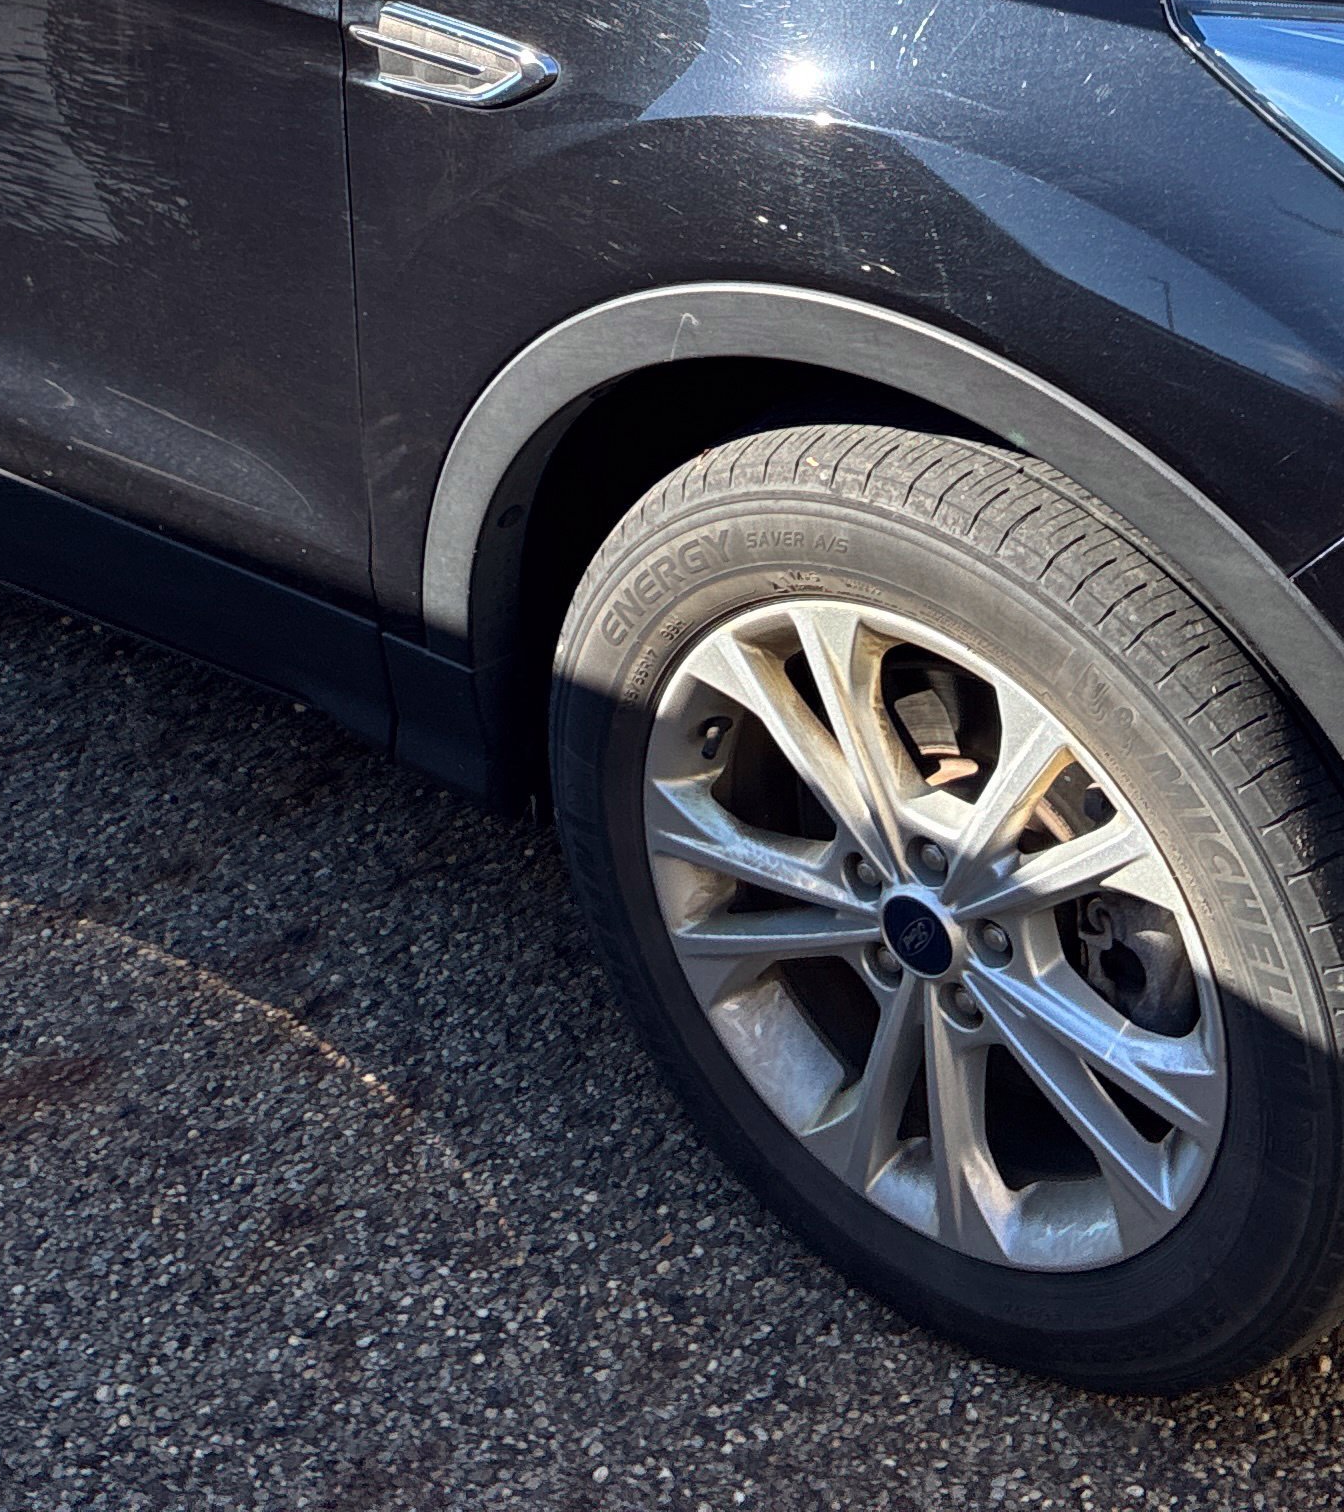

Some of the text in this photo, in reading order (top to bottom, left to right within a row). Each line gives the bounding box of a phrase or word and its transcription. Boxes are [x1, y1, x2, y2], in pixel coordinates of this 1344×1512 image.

[601, 530, 850, 647] ENERGY SAVER A/S
